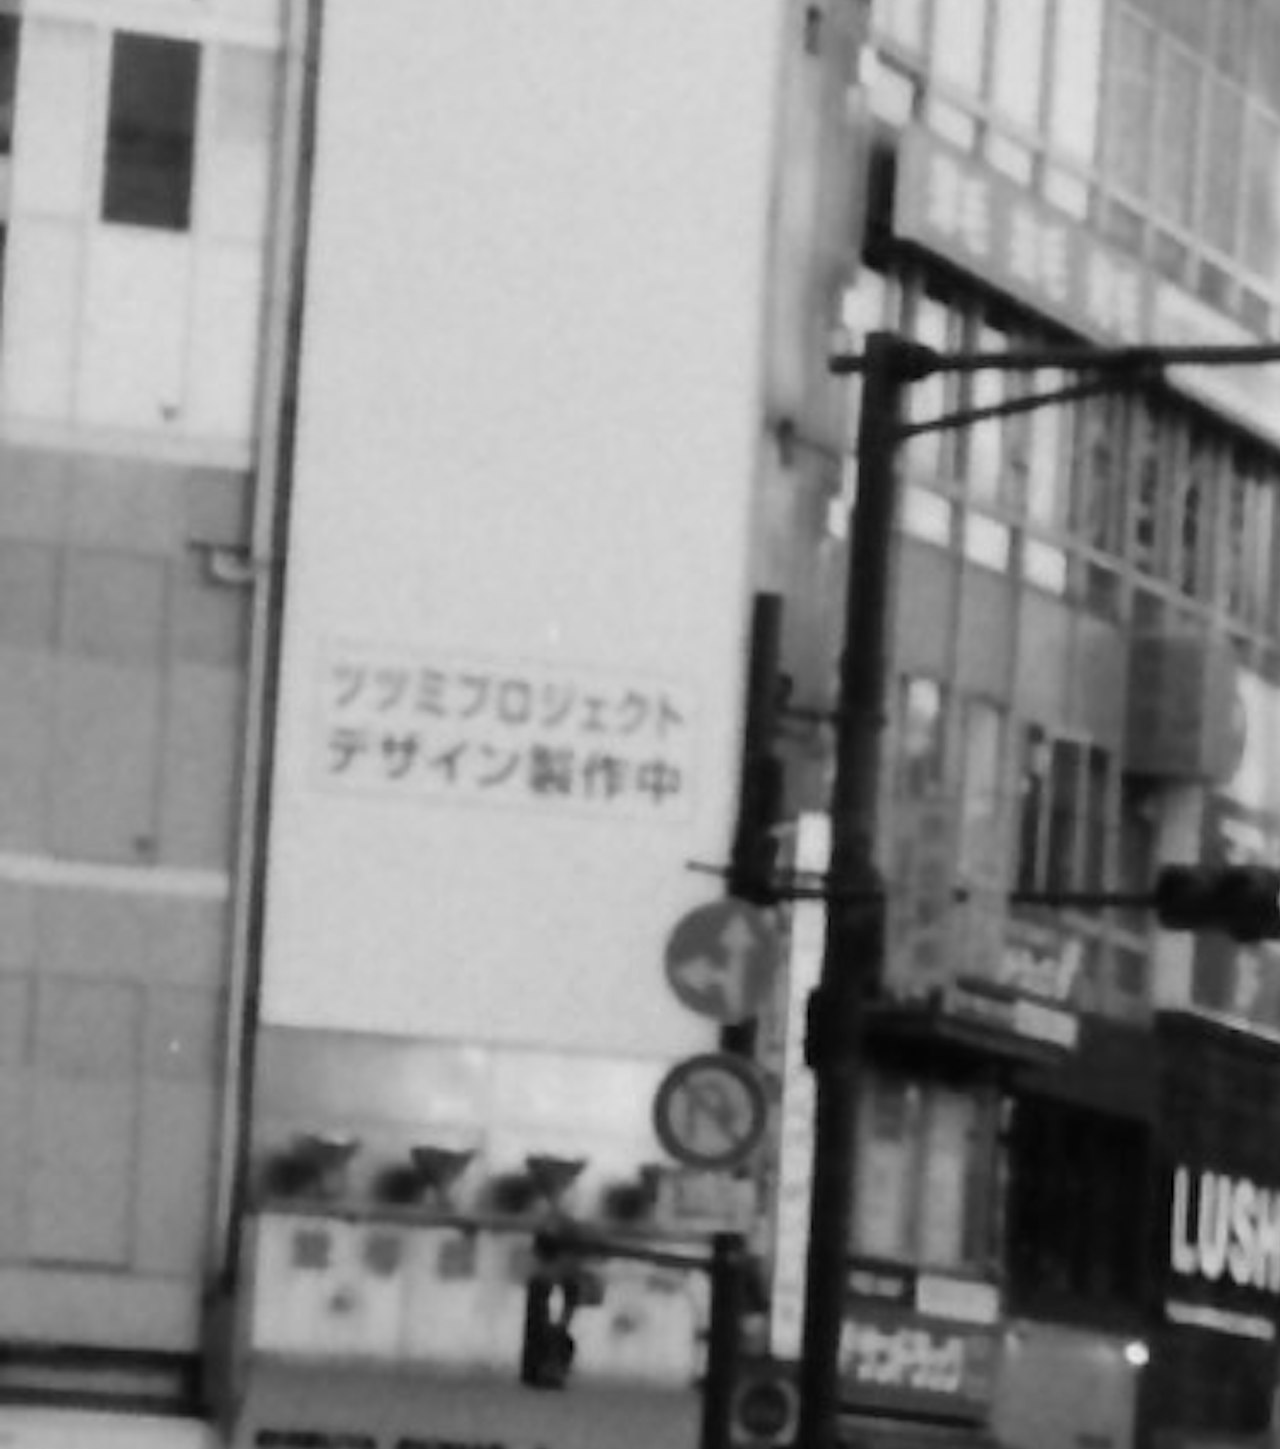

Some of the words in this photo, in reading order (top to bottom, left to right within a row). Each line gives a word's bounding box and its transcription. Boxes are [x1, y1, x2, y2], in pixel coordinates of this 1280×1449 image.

[328, 725, 682, 804] デザイン製作中
